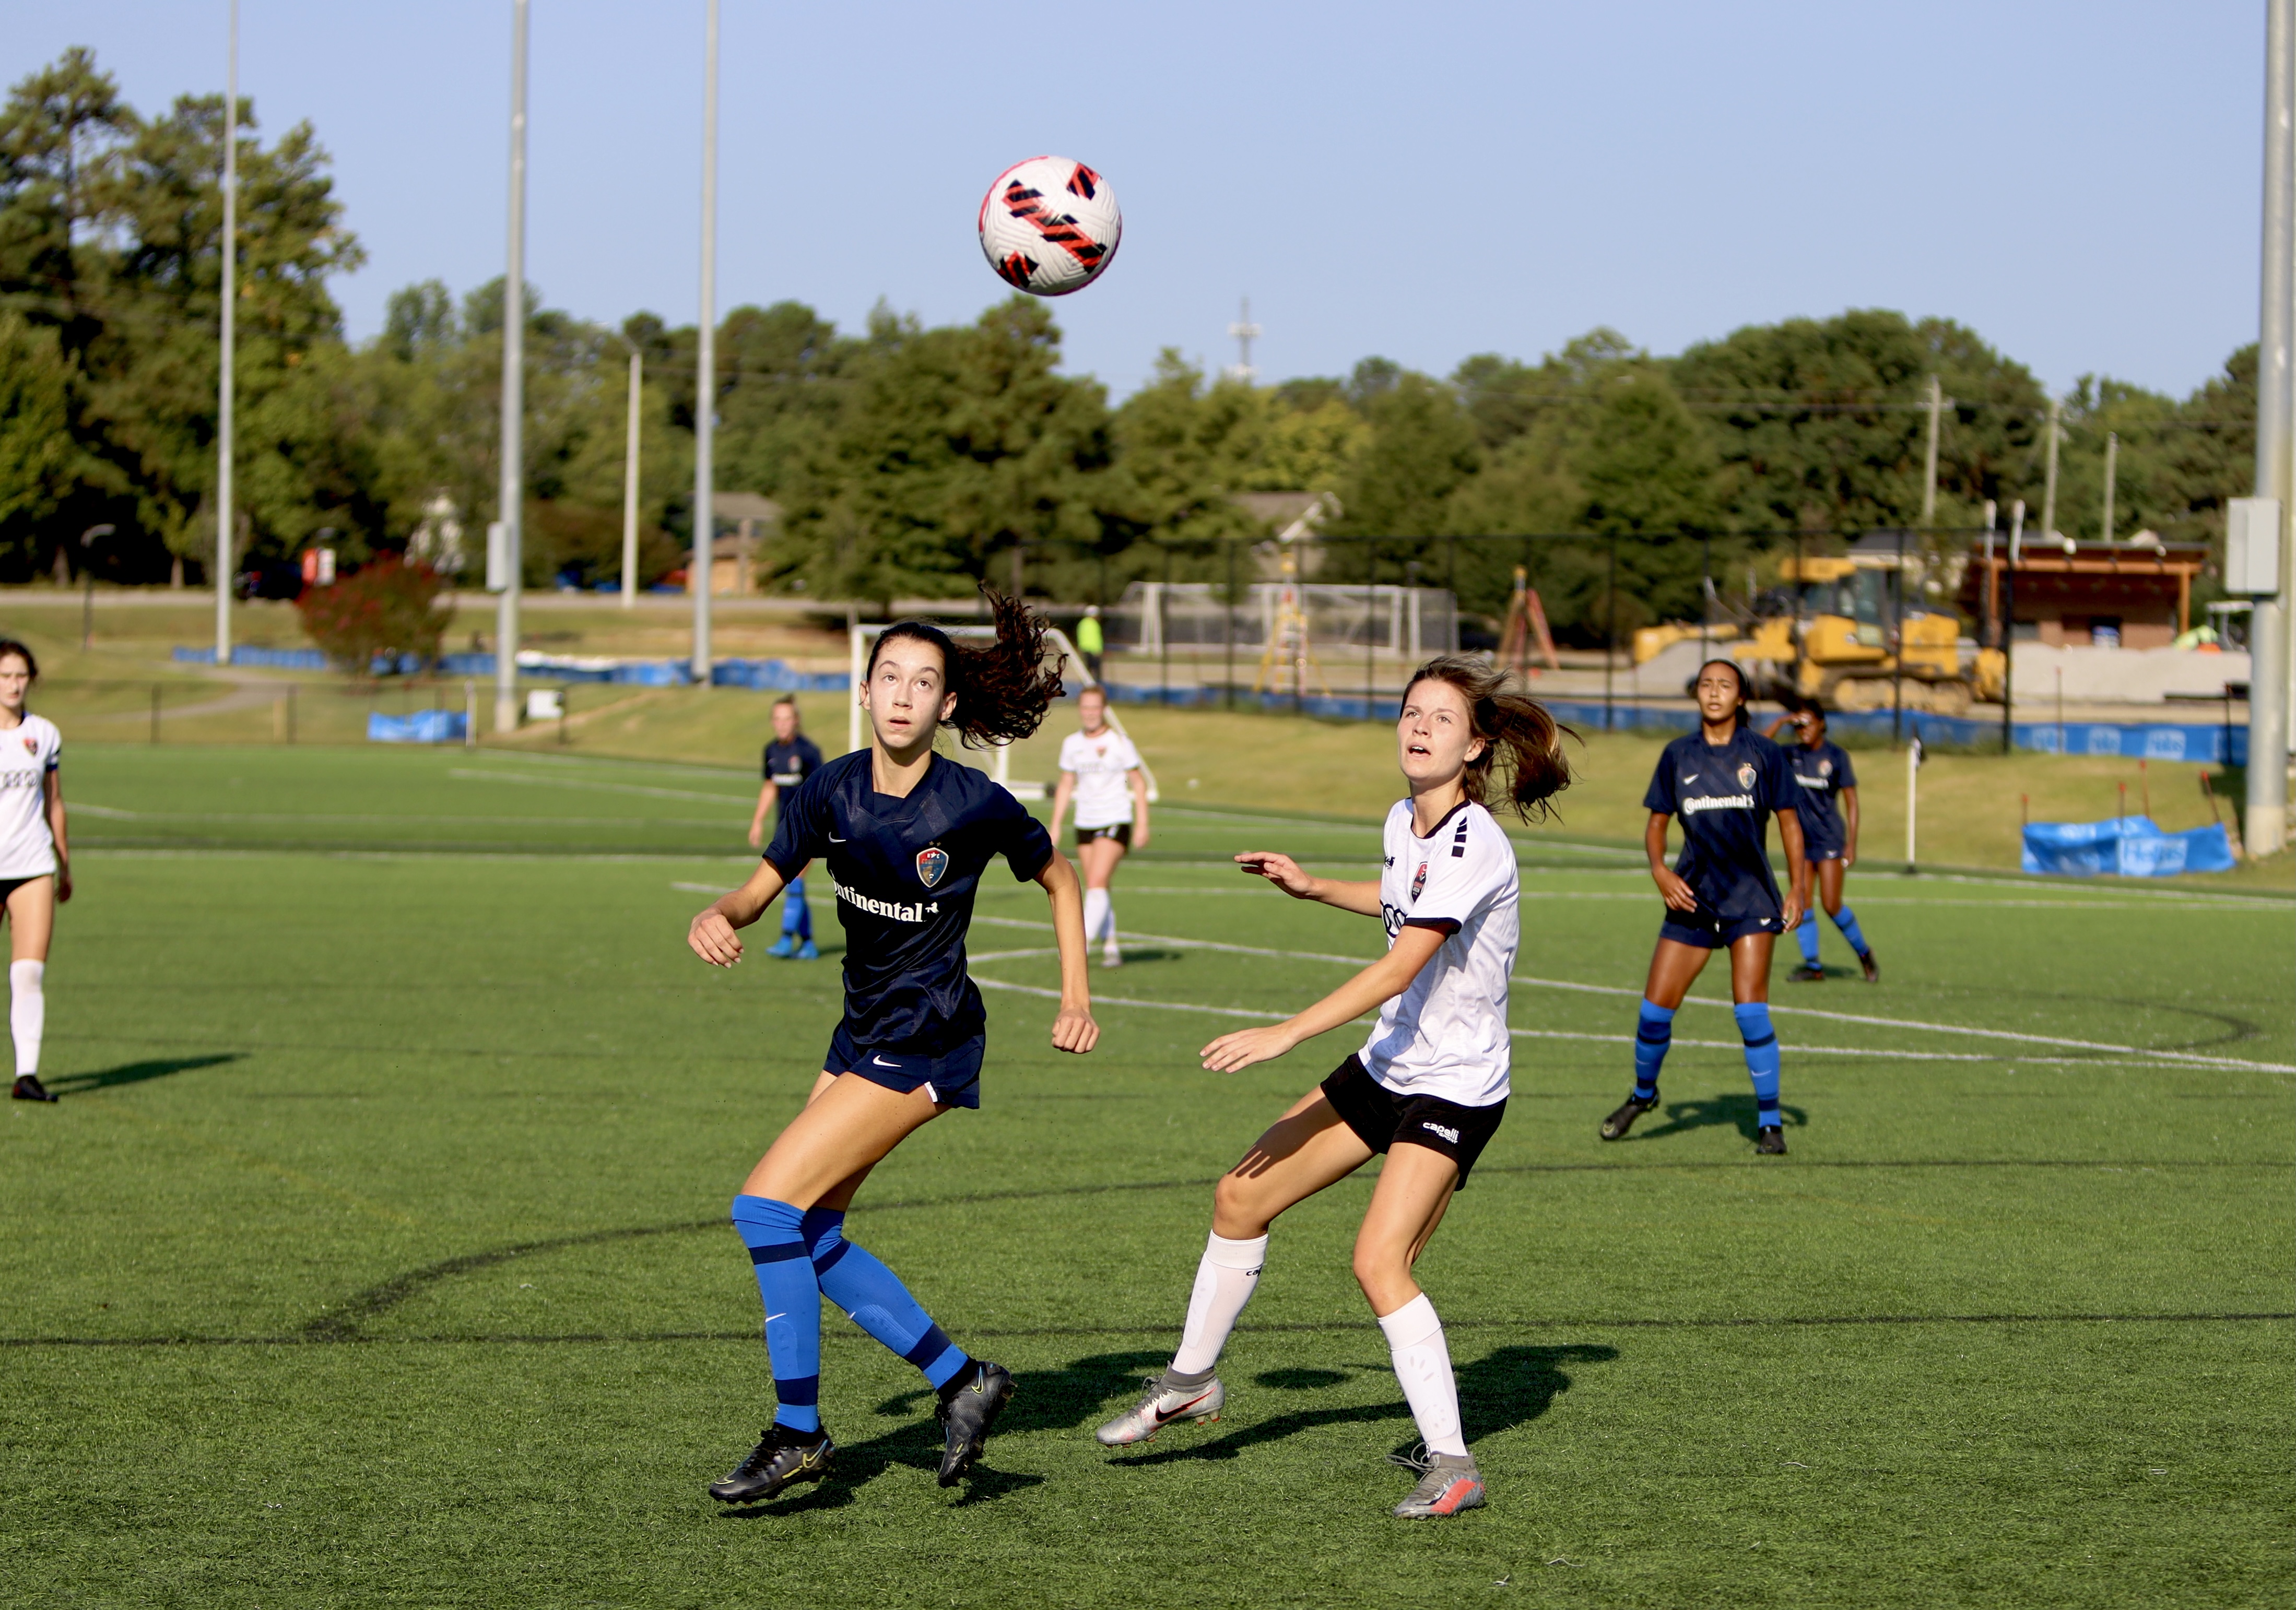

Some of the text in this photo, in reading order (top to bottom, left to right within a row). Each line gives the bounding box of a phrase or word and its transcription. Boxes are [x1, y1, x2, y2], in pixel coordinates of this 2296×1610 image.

[1683, 794, 1747, 815] Continental
[831, 875, 923, 922] ntinental
[1423, 1122, 1459, 1141] capelli
